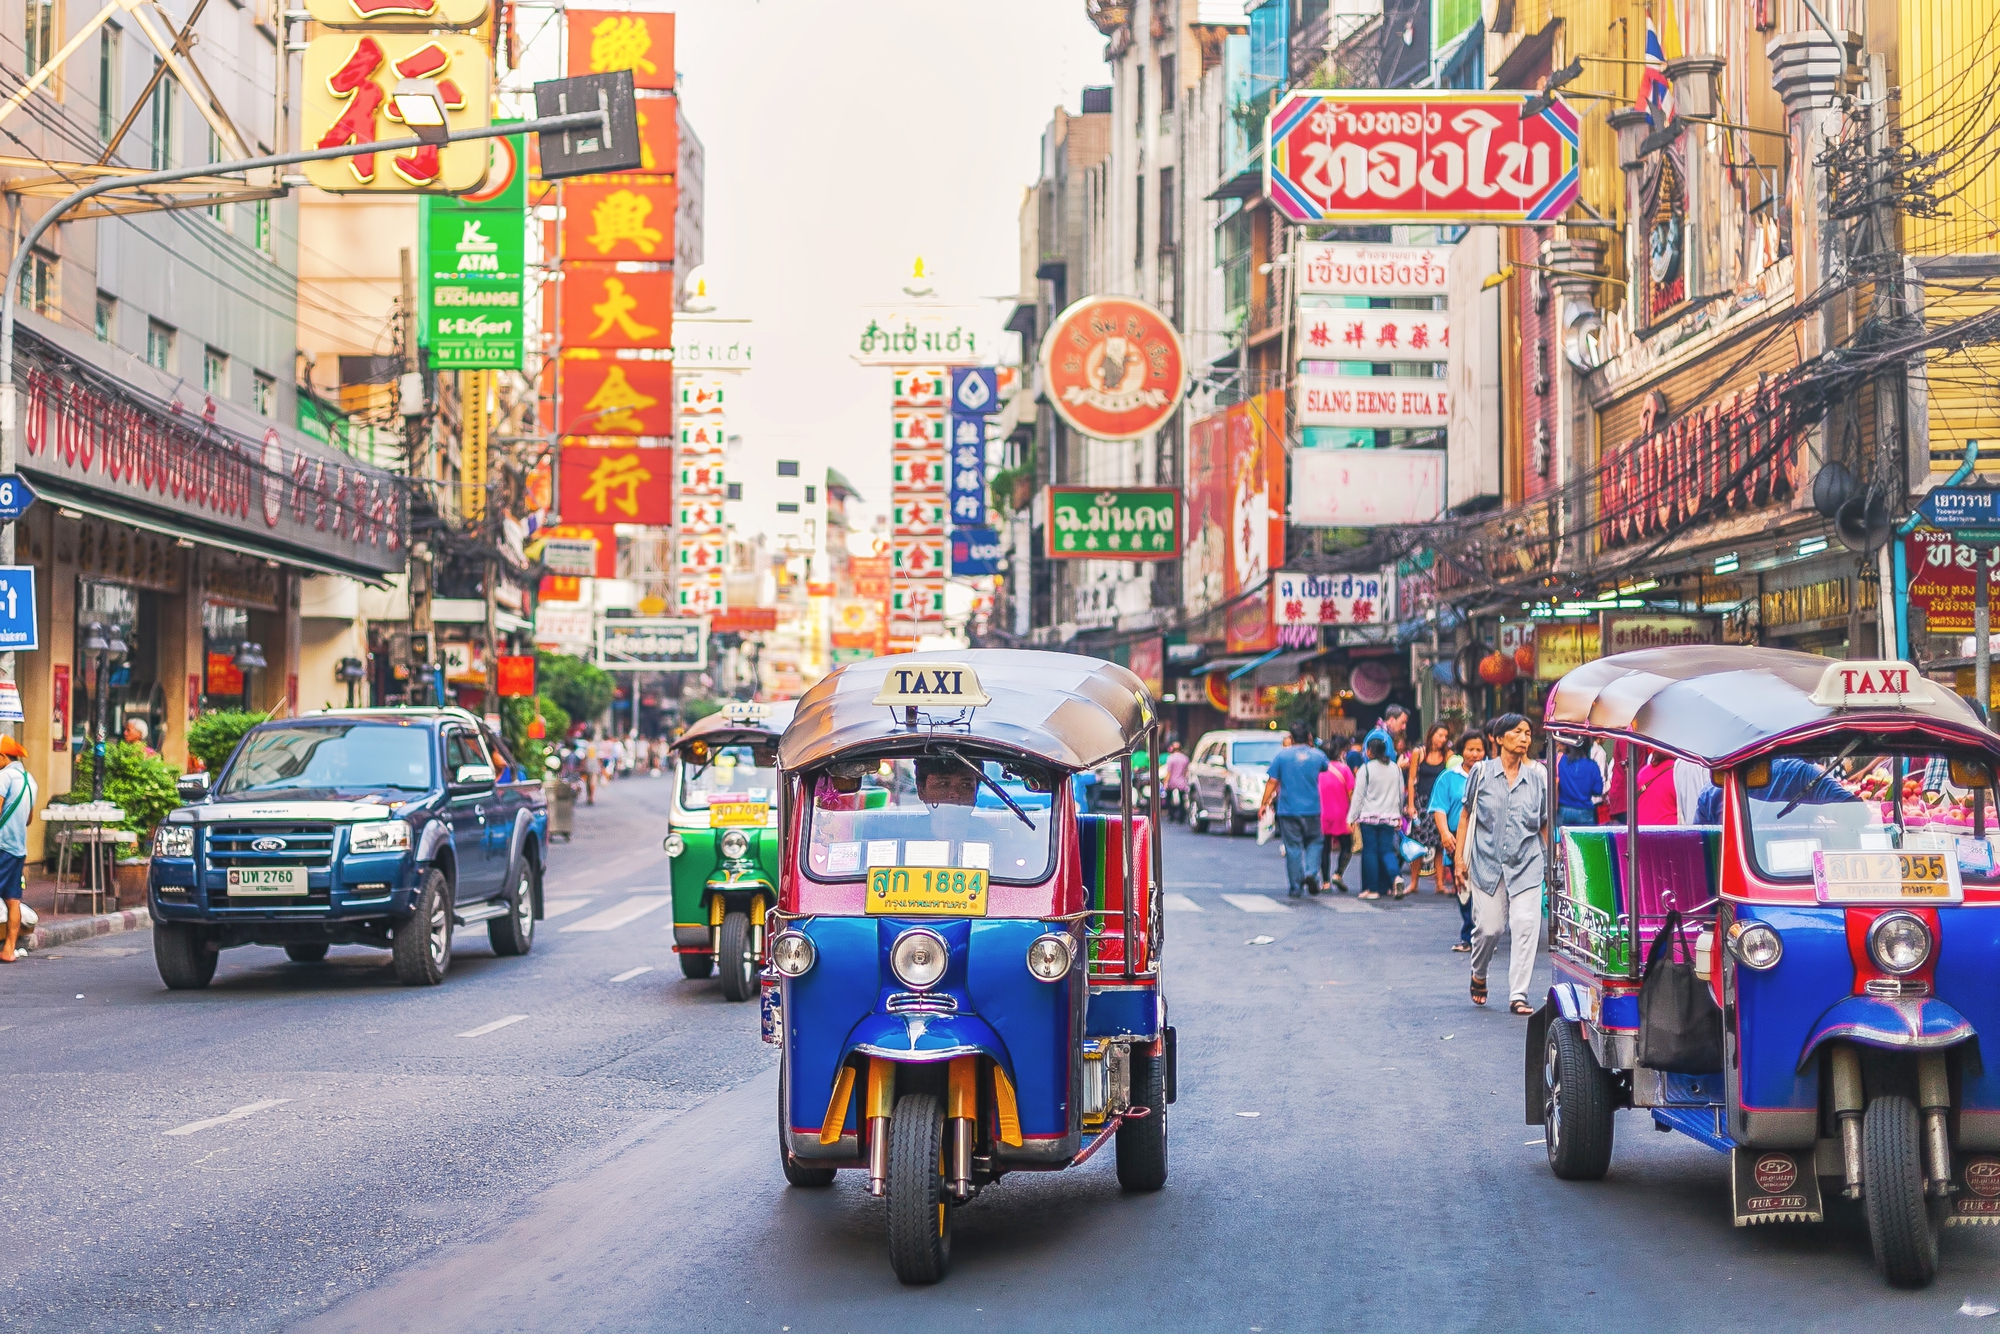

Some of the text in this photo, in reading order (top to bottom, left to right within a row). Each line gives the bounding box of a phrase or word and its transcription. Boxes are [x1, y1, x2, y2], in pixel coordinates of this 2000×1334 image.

[457, 253, 499, 271] ATM
[585, 15, 660, 516] 聯興大金行
[434, 291, 519, 306] EXCHANGE
[438, 314, 513, 339] K-Expert
[437, 347, 516, 360] WISDOM
[1307, 390, 1352, 414] SIANG
[1356, 390, 1396, 414] HENG
[1402, 391, 1432, 415] HUA
[1935, 493, 1992, 507] เยาวราช
[1056, 491, 1174, 532] ฉ.มั่นคง
[894, 670, 963, 695] TAXI
[1839, 669, 1910, 694] TAXI
[731, 706, 761, 714] TAXI
[738, 804, 766, 815] 7094
[263, 870, 293, 883] 2760
[1879, 855, 1945, 881] 2955
[922, 870, 982, 895] 1884
[884, 899, 968, 911] กรุงเทพมหานคร
